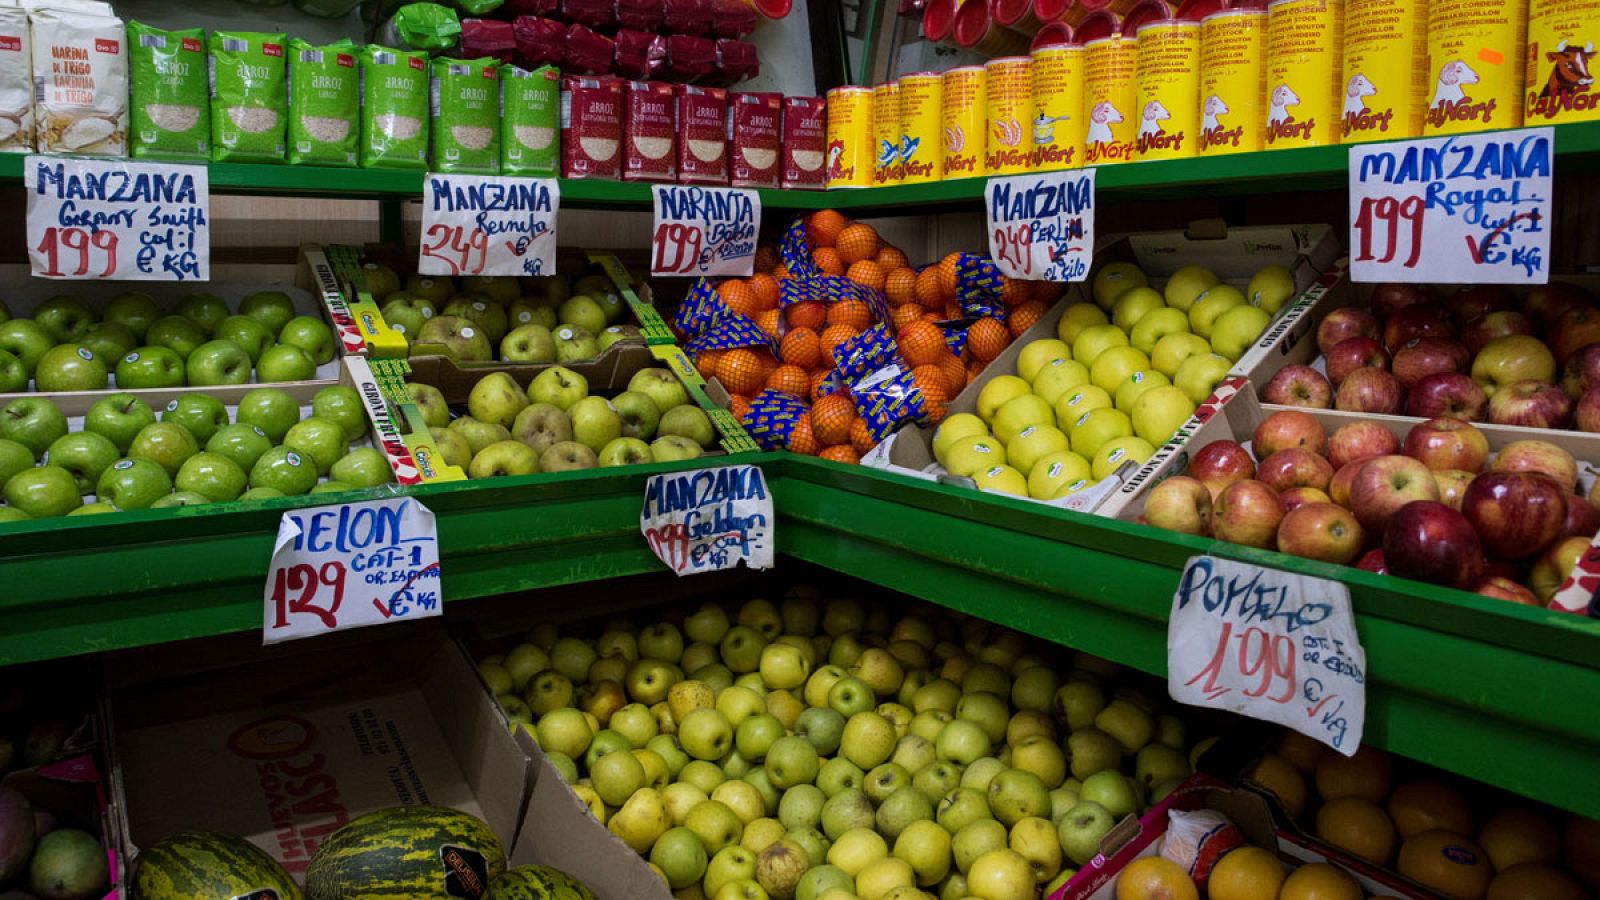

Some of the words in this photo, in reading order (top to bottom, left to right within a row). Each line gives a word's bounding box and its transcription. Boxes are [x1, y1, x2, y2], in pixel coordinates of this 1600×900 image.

[36, 162, 197, 204] MANZANA
[1360, 135, 1550, 184] MANZANA
[431, 178, 552, 212] MANZANA
[993, 176, 1091, 222] MANZANA
[422, 224, 489, 276] 249
[994, 224, 1032, 275] 249
[644, 467, 766, 520] MANZANA
[271, 561, 347, 628] 129
